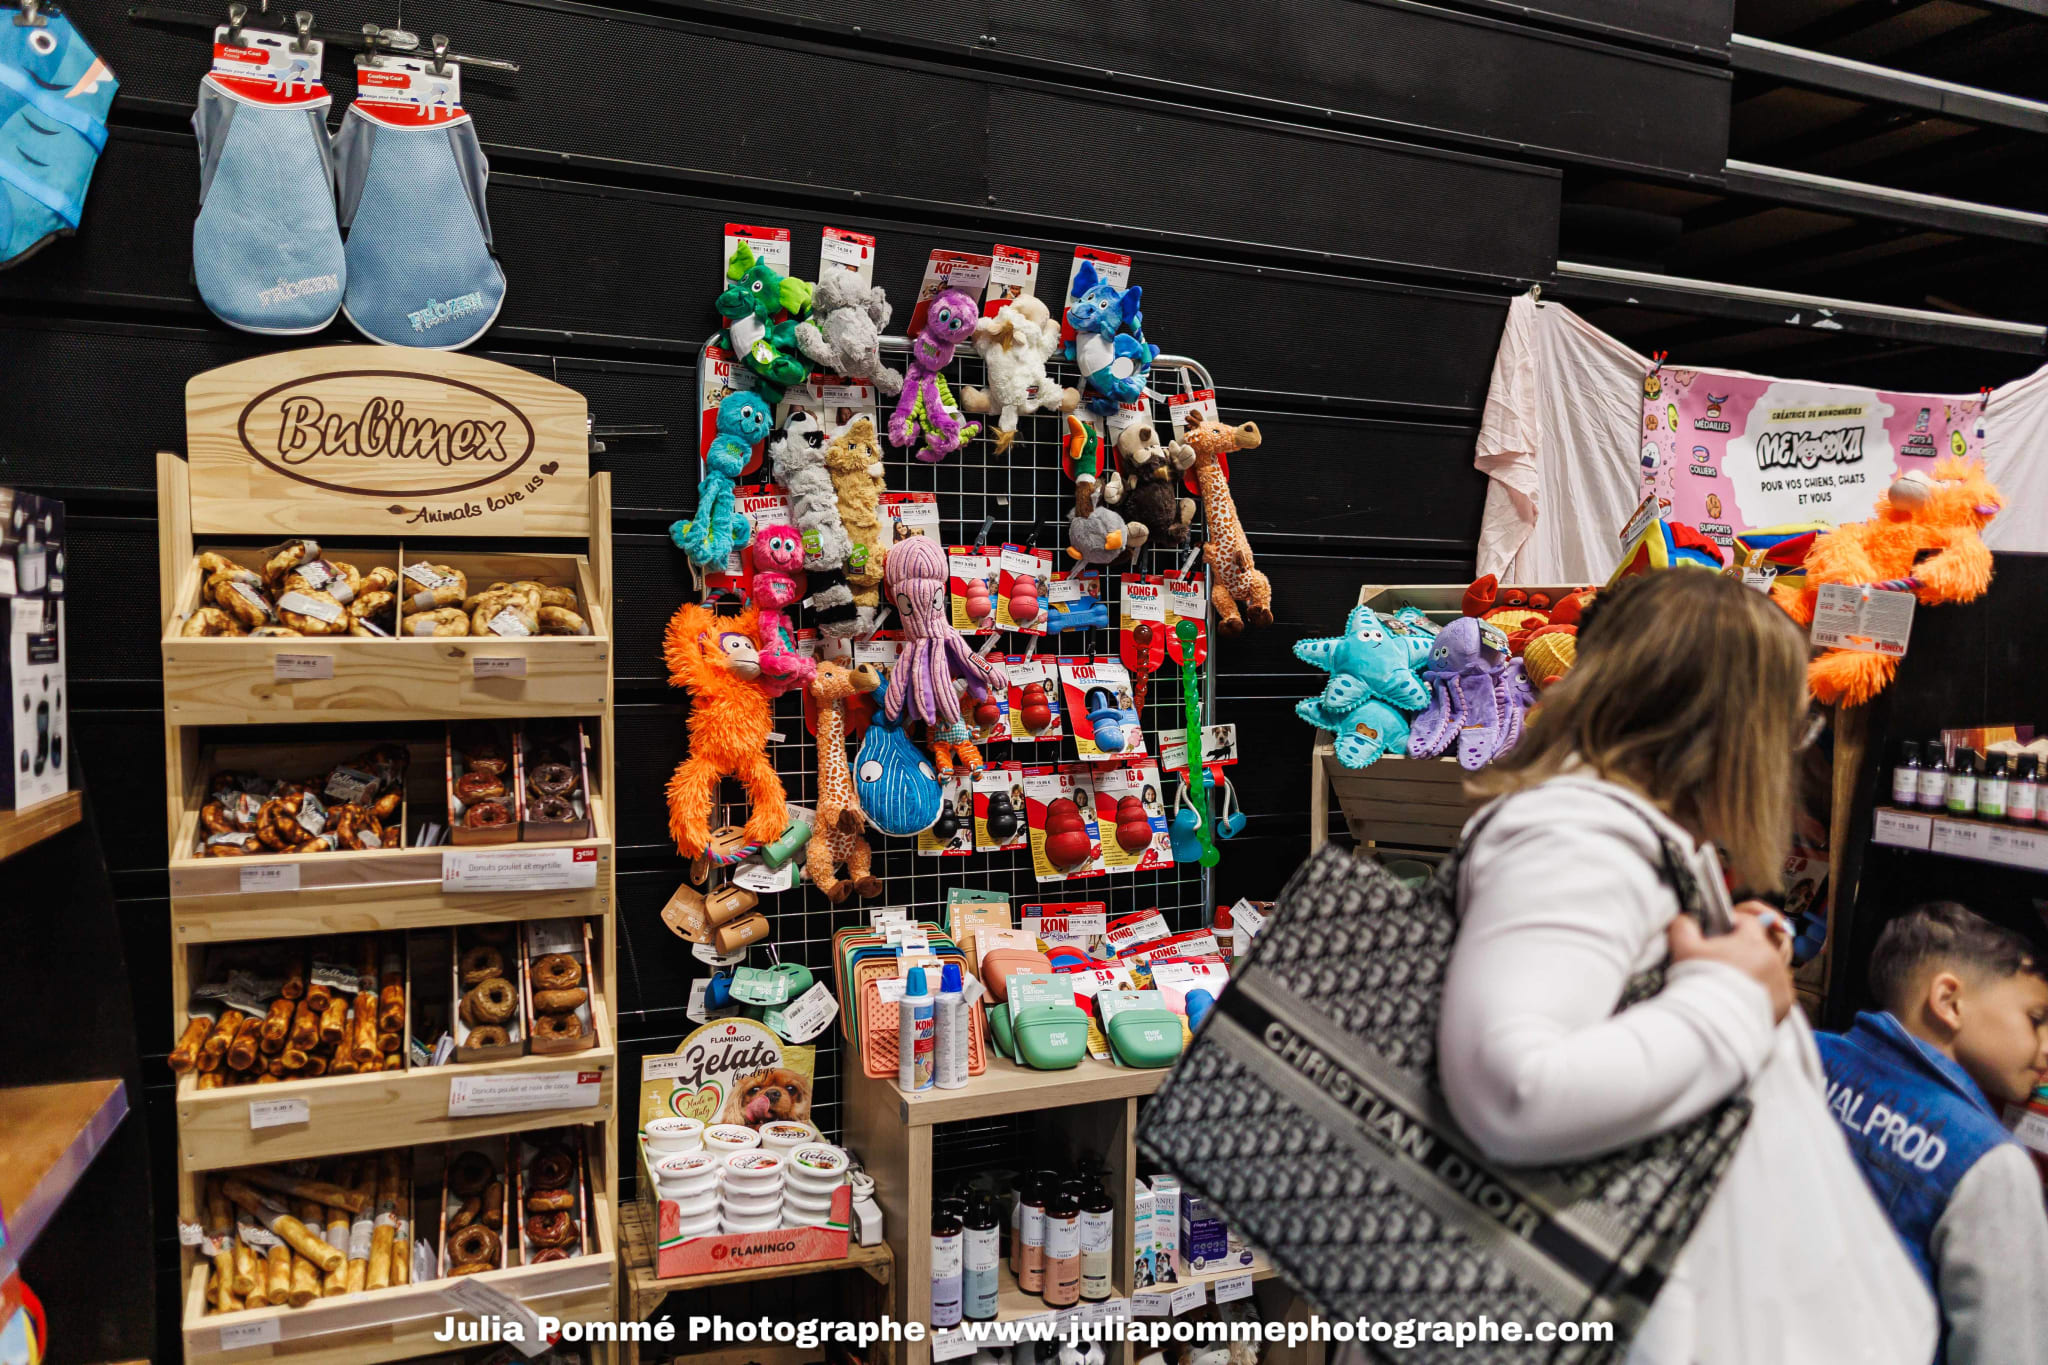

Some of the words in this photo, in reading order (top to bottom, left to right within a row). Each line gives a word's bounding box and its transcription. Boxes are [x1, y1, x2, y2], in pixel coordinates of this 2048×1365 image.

[407, 291, 483, 333] FROZEN
[1808, 410, 1816, 418] DE
[277, 396, 507, 467] Bubimex
[1694, 418, 1731, 433] MÉDAILLES
[1689, 463, 1717, 478] COLLIERS
[1761, 481, 1783, 492] POUR
[1785, 479, 1802, 490] VOS
[1804, 476, 1837, 488] CHIENS,
[1838, 473, 1865, 485] CHATS
[406, 502, 482, 526] Animals
[487, 488, 526, 513] love
[526, 473, 546, 495] us
[743, 497, 778, 513] KONG
[1798, 494, 1808, 505] ET
[1810, 492, 1832, 503] VOUS
[1700, 522, 1732, 535] SUPPORTS
[1127, 585, 1151, 597] KONG
[1169, 581, 1192, 593] KONG
[971, 653, 987, 671] KONG
[1072, 666, 1096, 680] KON
[468, 863, 496, 872] Donuts
[497, 862, 522, 872] poulet
[533, 861, 562, 872] myrtille
[1040, 918, 1069, 933] KON
[1107, 927, 1134, 944] KONG
[1149, 945, 1178, 961] KONG
[710, 1035, 752, 1044] FLAMINGO
[678, 1040, 780, 1088] Gelato
[731, 1066, 750, 1087] for
[749, 1064, 777, 1082] dogs
[471, 1087, 497, 1096] Donuts
[685, 1094, 707, 1110] Made
[692, 1107, 711, 1119] Italy
[1264, 1021, 1435, 1162] CHRISTIAN
[1436, 1154, 1540, 1241] DIOR
[1862, 1103, 1948, 1172] PROD
[799, 1150, 838, 1164] Gelato
[730, 1241, 796, 1258] FLAMINGO
